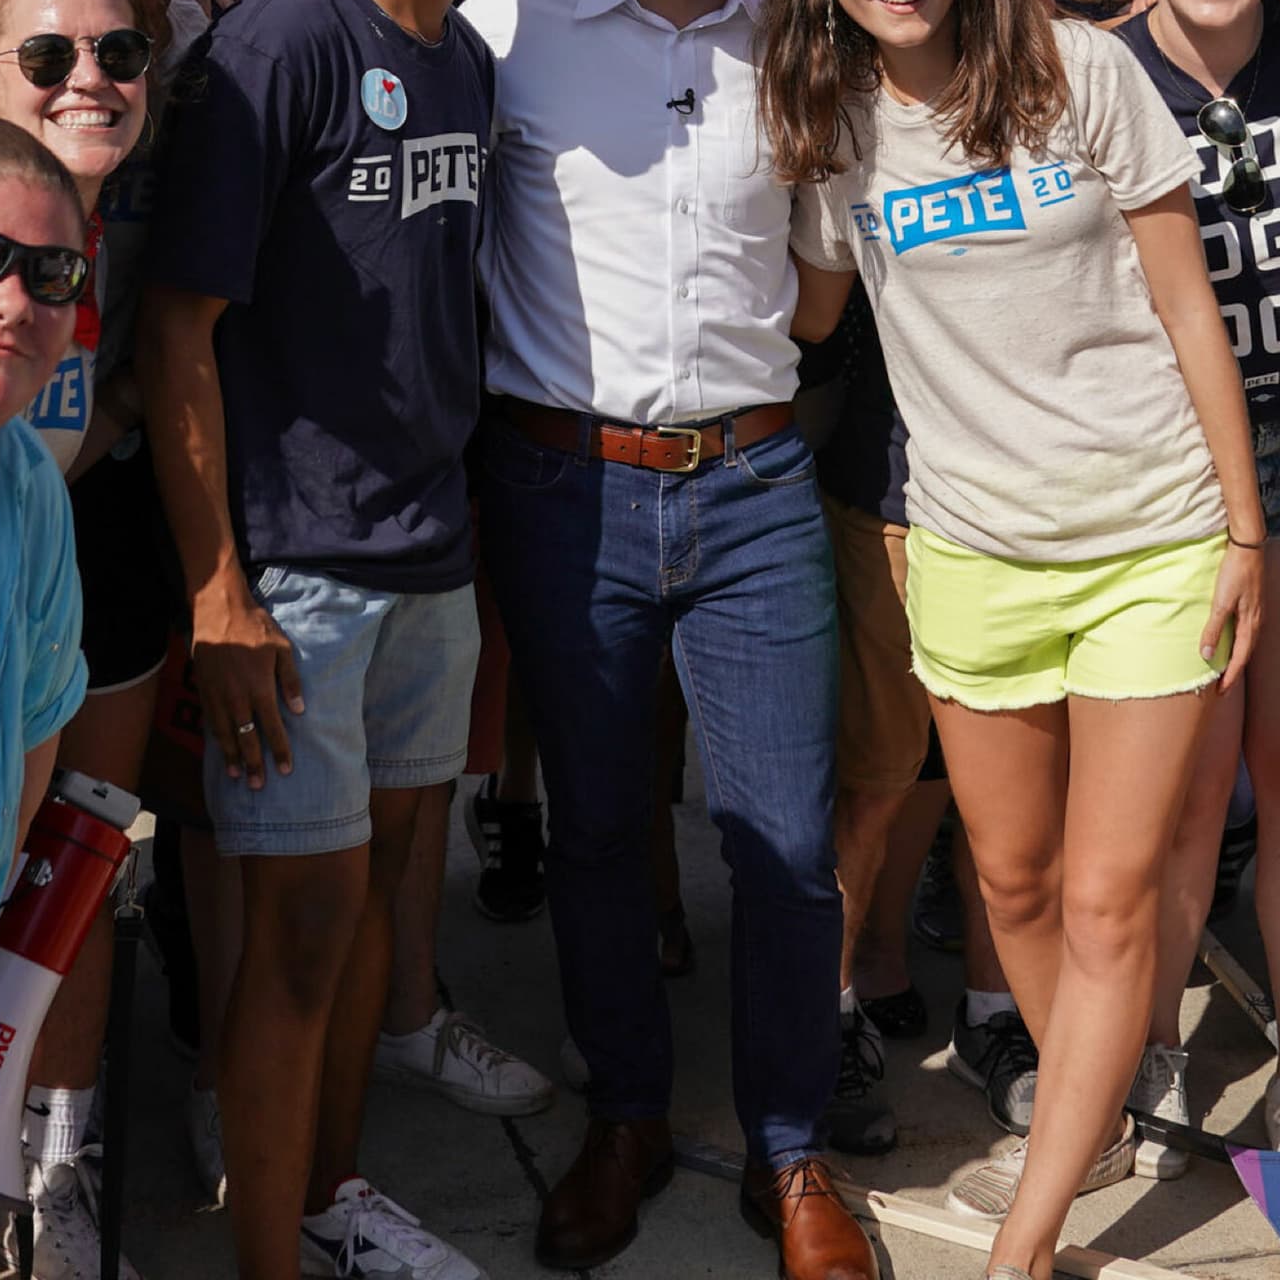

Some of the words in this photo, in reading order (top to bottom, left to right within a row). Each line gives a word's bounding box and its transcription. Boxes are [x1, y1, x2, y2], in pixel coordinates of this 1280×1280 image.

[349, 166, 392, 192] 20
[411, 144, 477, 201] PETE
[854, 212, 879, 233] 20
[891, 177, 1012, 242] PETE
[1032, 169, 1071, 198] 20
